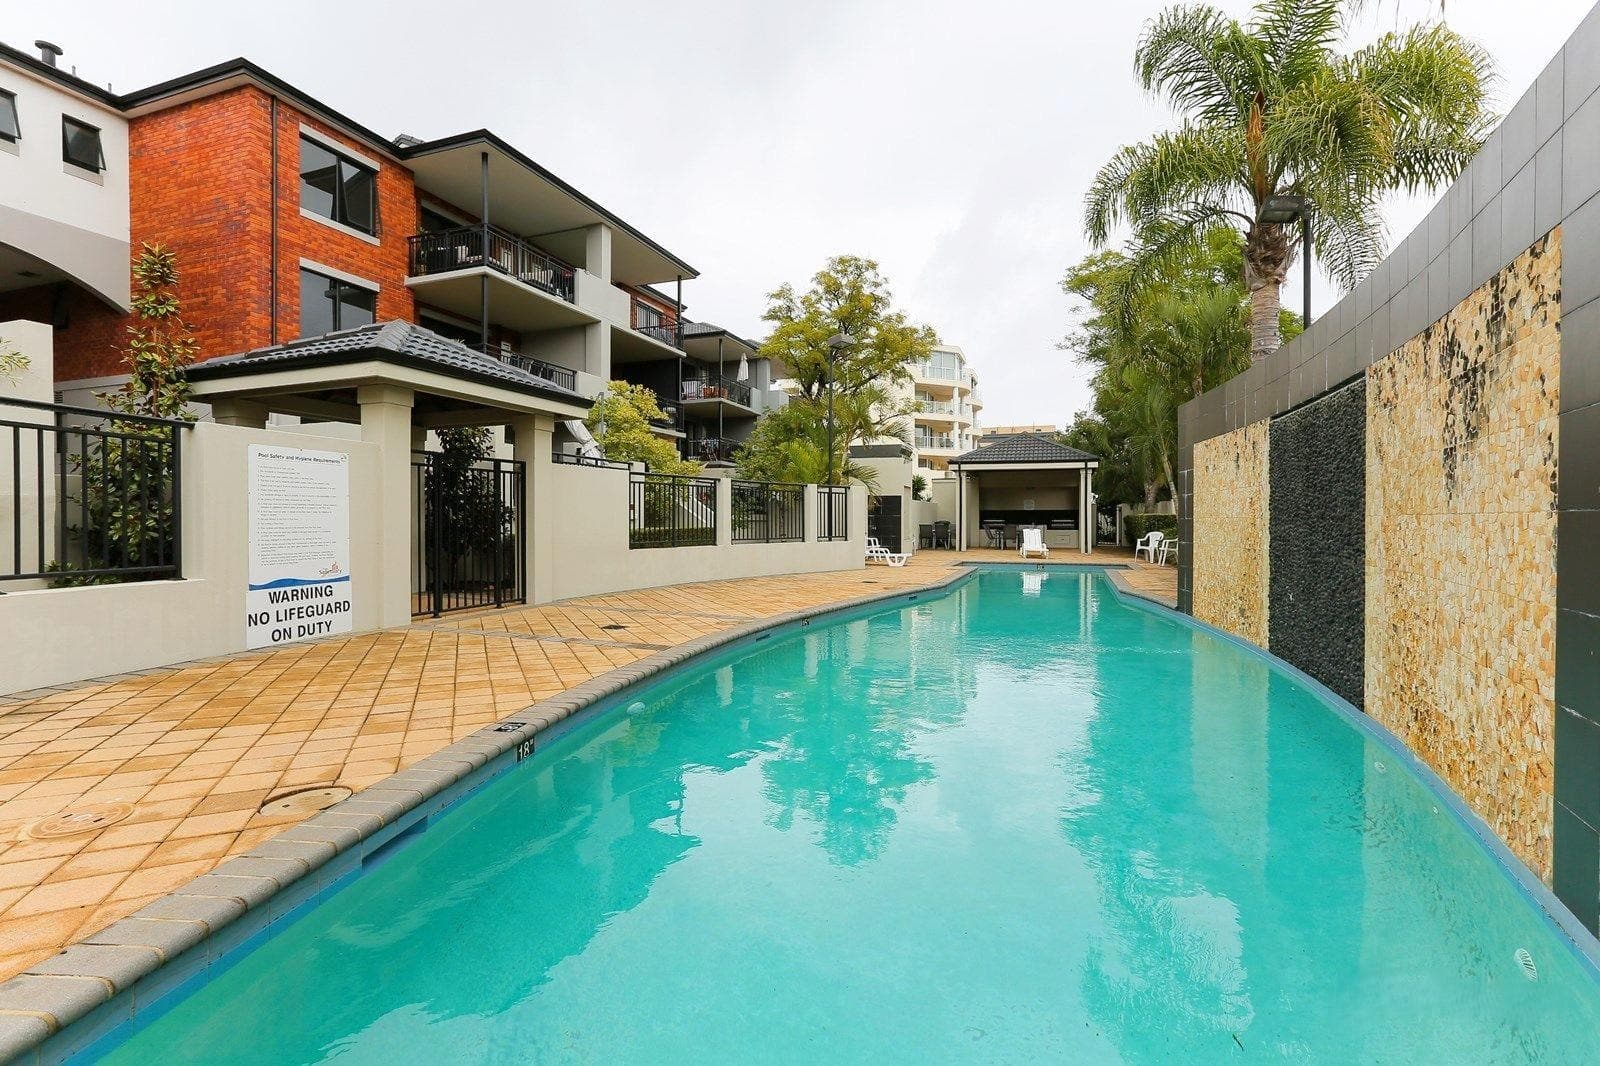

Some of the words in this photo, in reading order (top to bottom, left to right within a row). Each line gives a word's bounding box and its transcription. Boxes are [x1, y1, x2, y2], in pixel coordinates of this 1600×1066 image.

[268, 585, 333, 604] WARNING
[248, 612, 270, 627] NO
[276, 600, 350, 623] LIFEGUARD
[271, 627, 292, 642] ON
[298, 620, 332, 638] DUTY
